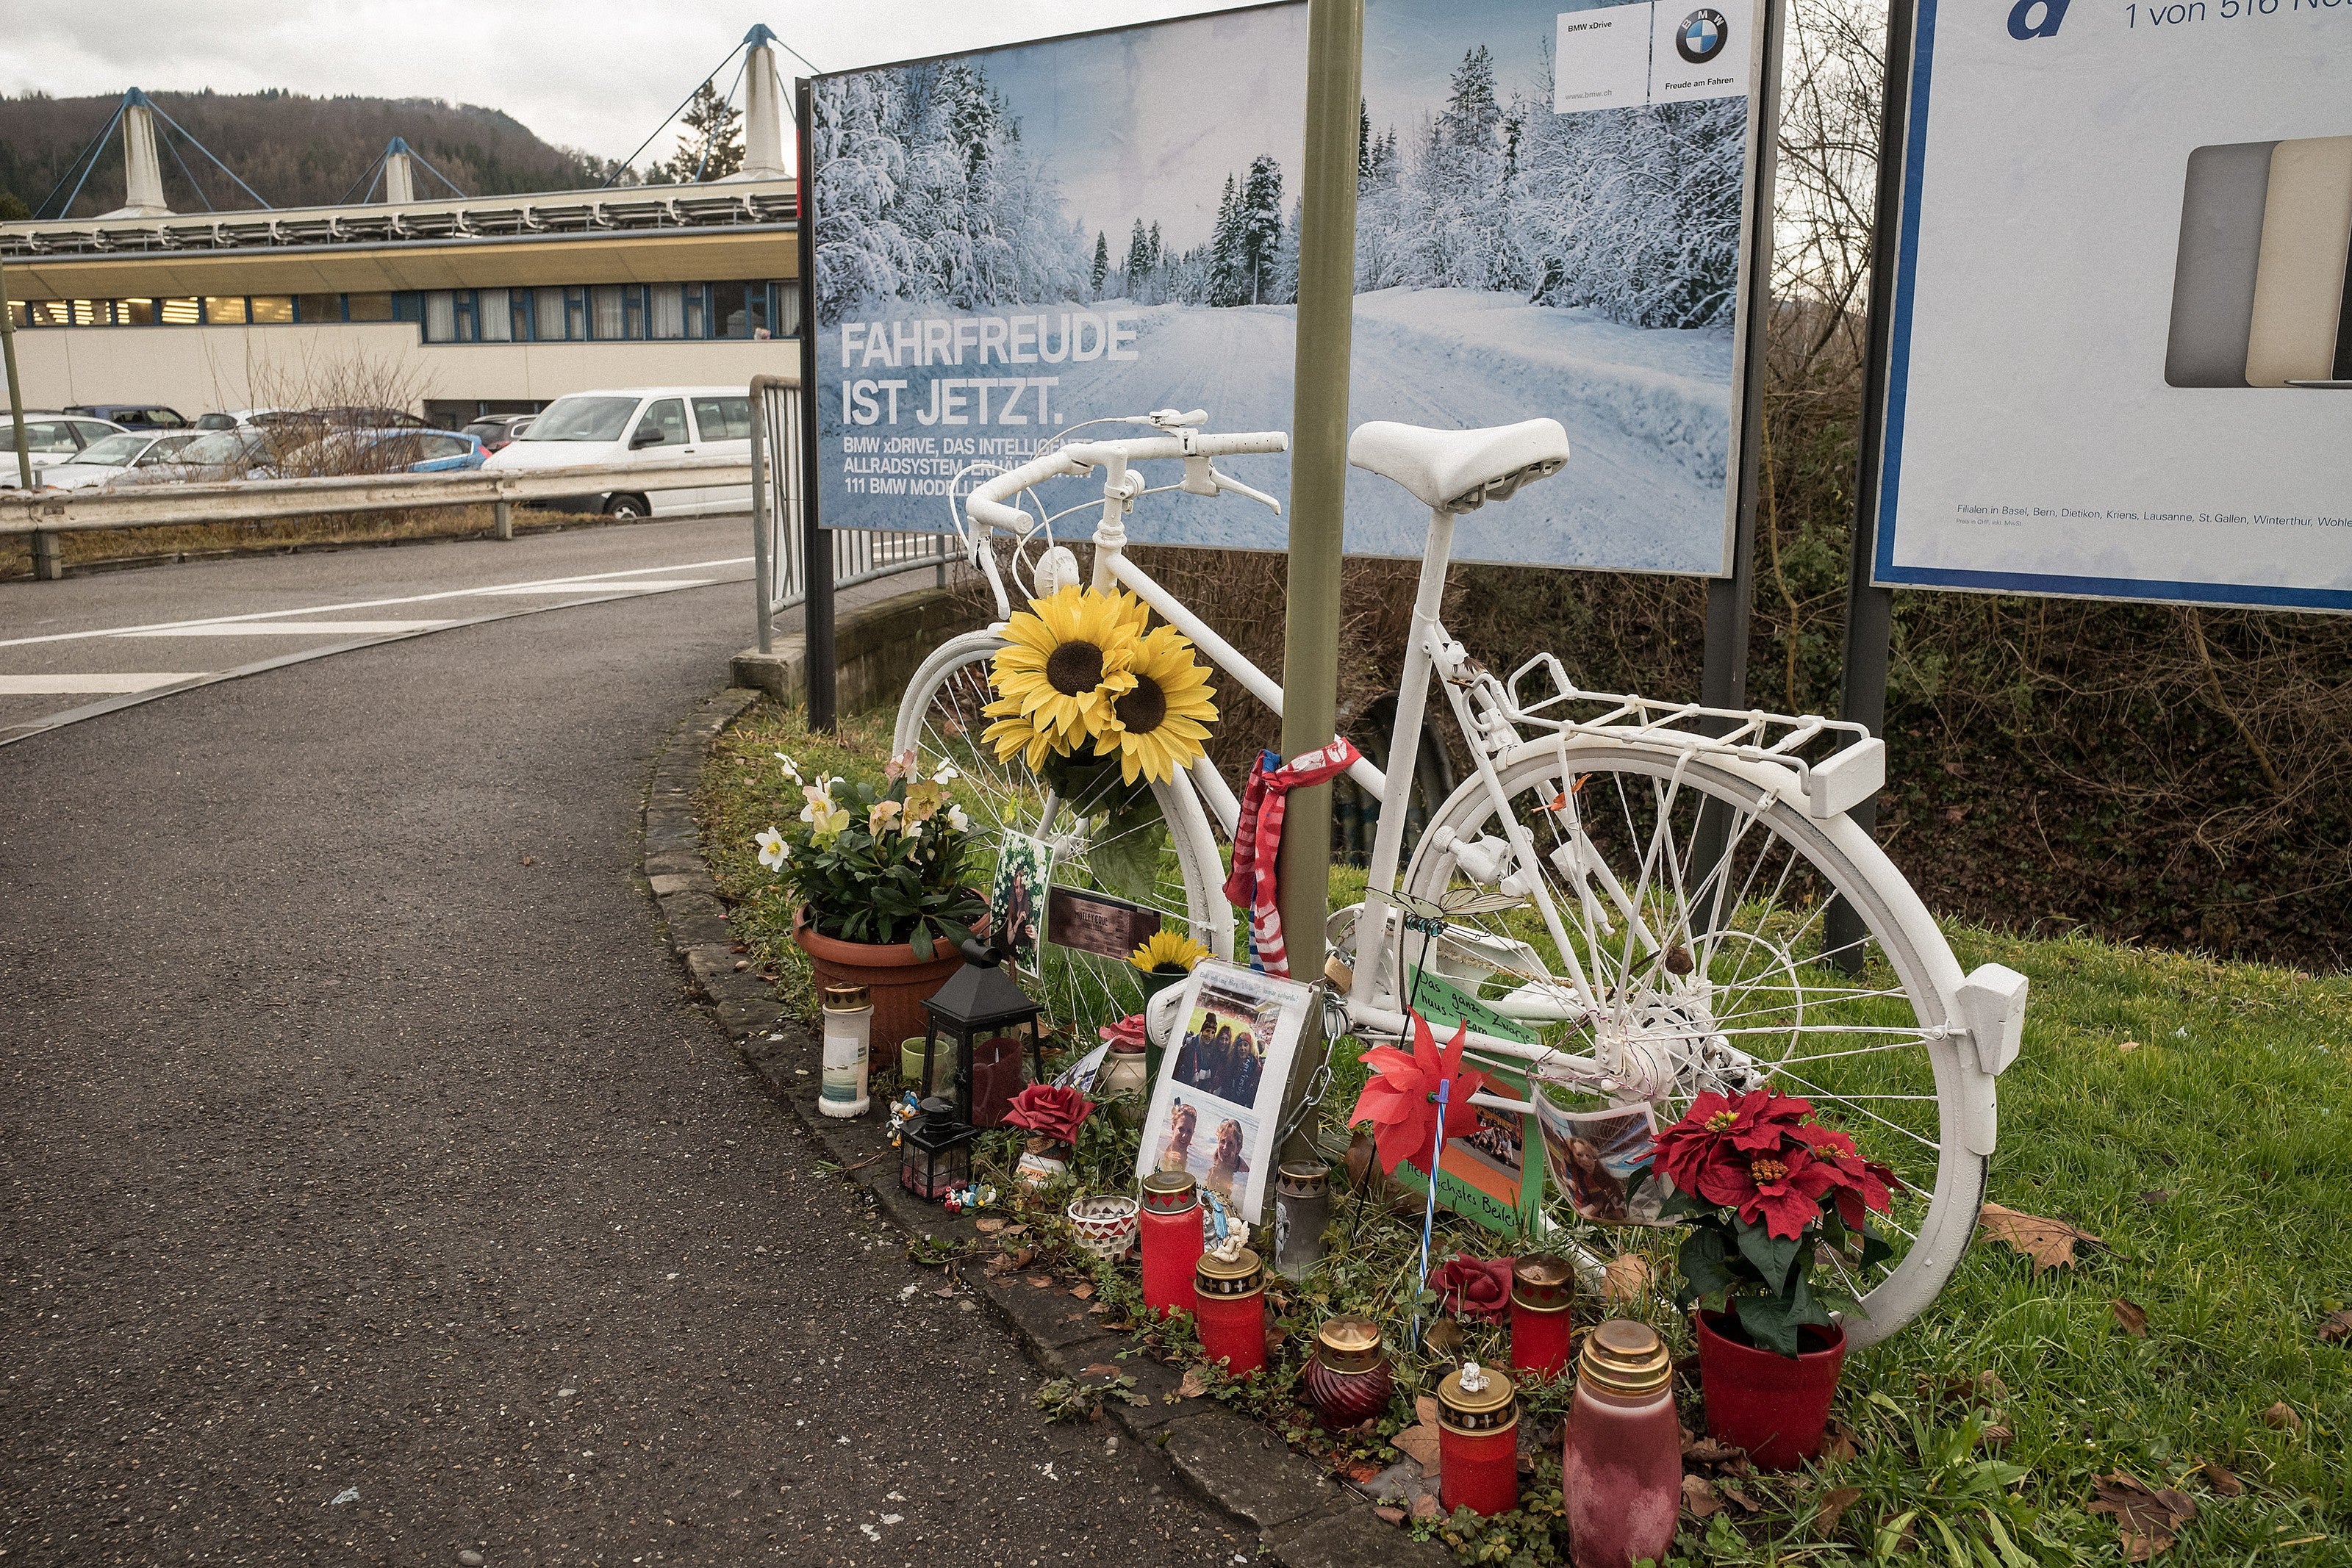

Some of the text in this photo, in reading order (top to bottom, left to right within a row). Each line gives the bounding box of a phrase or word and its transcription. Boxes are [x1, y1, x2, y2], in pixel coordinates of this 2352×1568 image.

[1568, 21, 1613, 32] BMW xDrive
[1681, 10, 1724, 30] BMW
[2126, 3, 2136, 29] 1
[2149, 2, 2205, 26] von
[1665, 81, 1692, 90] Freude
[1707, 77, 1734, 86] Fahren
[1565, 90, 1613, 100] www.bmw.ch
[842, 312, 1139, 367] FAHRFREUDE
[842, 377, 1063, 425] IST JETZT.
[843, 436, 1094, 458] BMW xDRIVE, DAS INTELLIGE
[845, 478, 988, 497] 111 BMW MODELL
[1957, 505, 1987, 514] Filialen
[1990, 506, 1999, 514] in
[2001, 506, 2029, 517] Basel,
[2033, 508, 2058, 517] Bern,
[2061, 508, 2103, 519] Dietikon,
[2107, 510, 2140, 521] Kriens,
[2143, 511, 2195, 522] Lausanne,
[2198, 513, 2212, 522] St.
[2215, 514, 2249, 525] Gallen,
[2254, 515, 2314, 527] Winterthur,
[1420, 970, 1441, 993] Das
[1451, 993, 1486, 1018] ganze
[1407, 1161, 1477, 1206] Herichstes
[1482, 1195, 1524, 1229] Beilei
